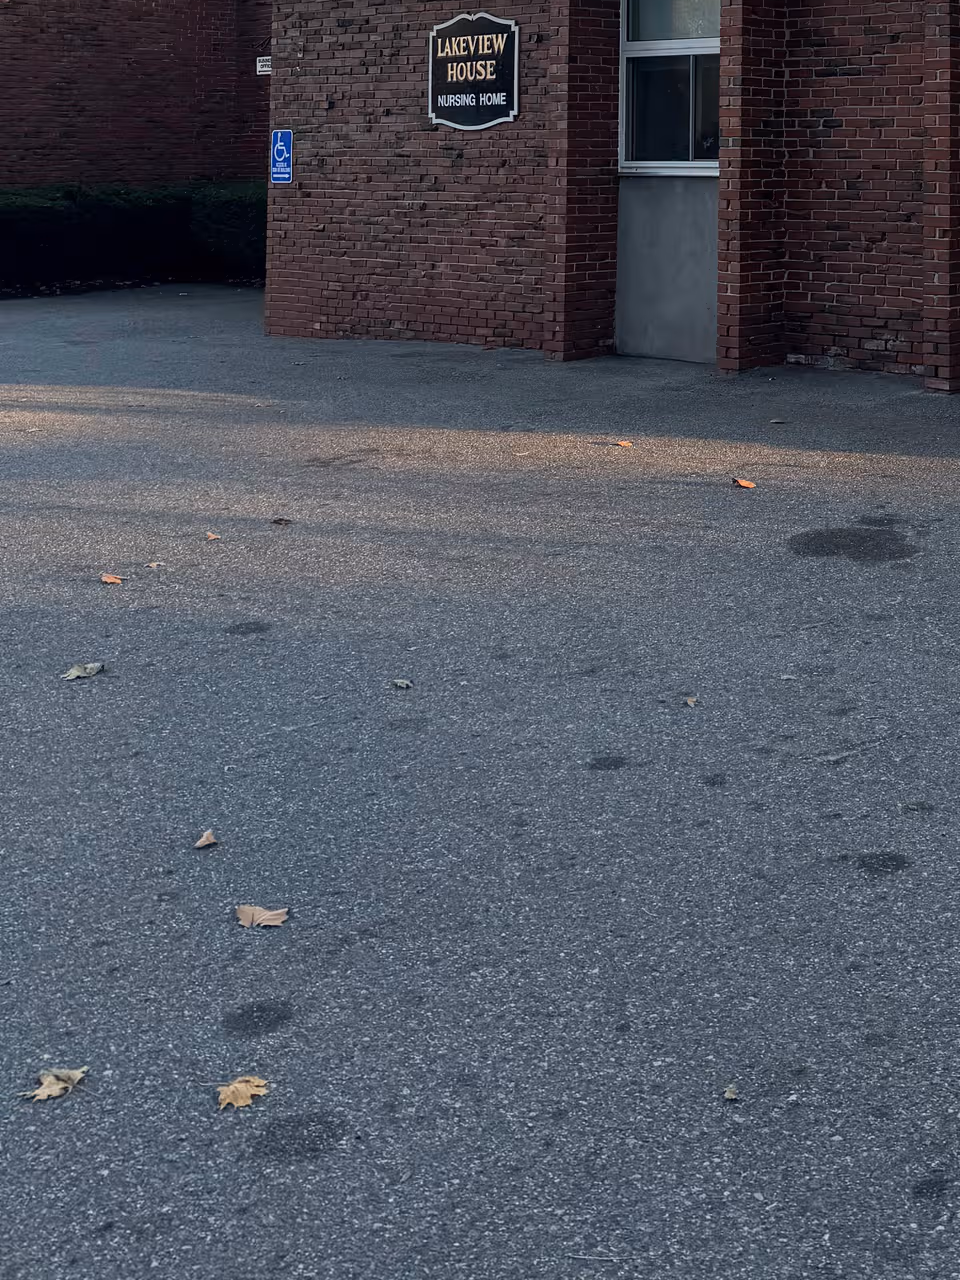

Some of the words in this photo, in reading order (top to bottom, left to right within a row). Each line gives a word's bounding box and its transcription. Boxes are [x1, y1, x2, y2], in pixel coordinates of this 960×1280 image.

[437, 34, 508, 57] LAKEVIEW
[447, 60, 497, 81] HOUSE
[437, 94, 476, 107] NURSING
[479, 92, 507, 106] HOME
